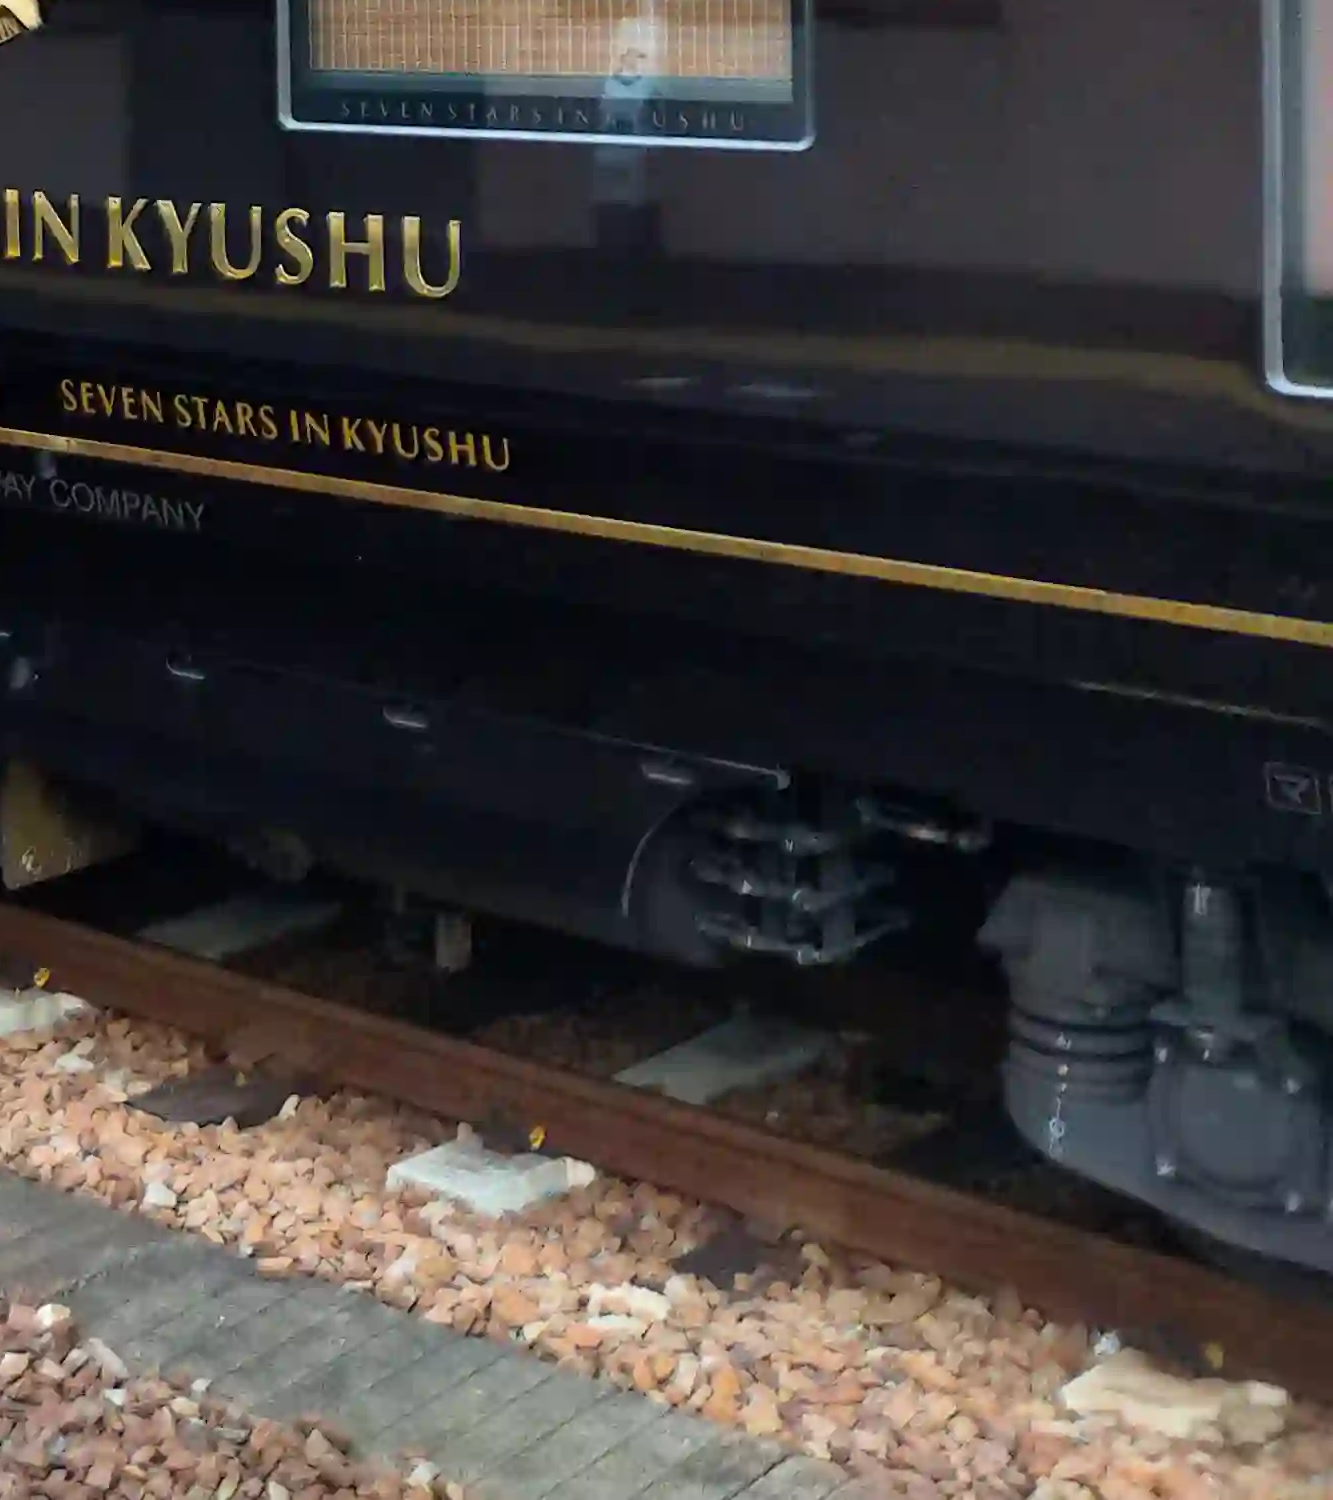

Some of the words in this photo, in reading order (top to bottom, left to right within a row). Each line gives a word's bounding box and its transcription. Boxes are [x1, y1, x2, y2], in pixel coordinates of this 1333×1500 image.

[2, 188, 80, 266] IN
[107, 196, 462, 299] KYUSHU
[61, 378, 164, 424] SEVEN
[174, 393, 279, 441] STARS
[290, 409, 331, 448] IN
[341, 416, 511, 473] KYUSHU
[49, 479, 205, 531] COMPANY
